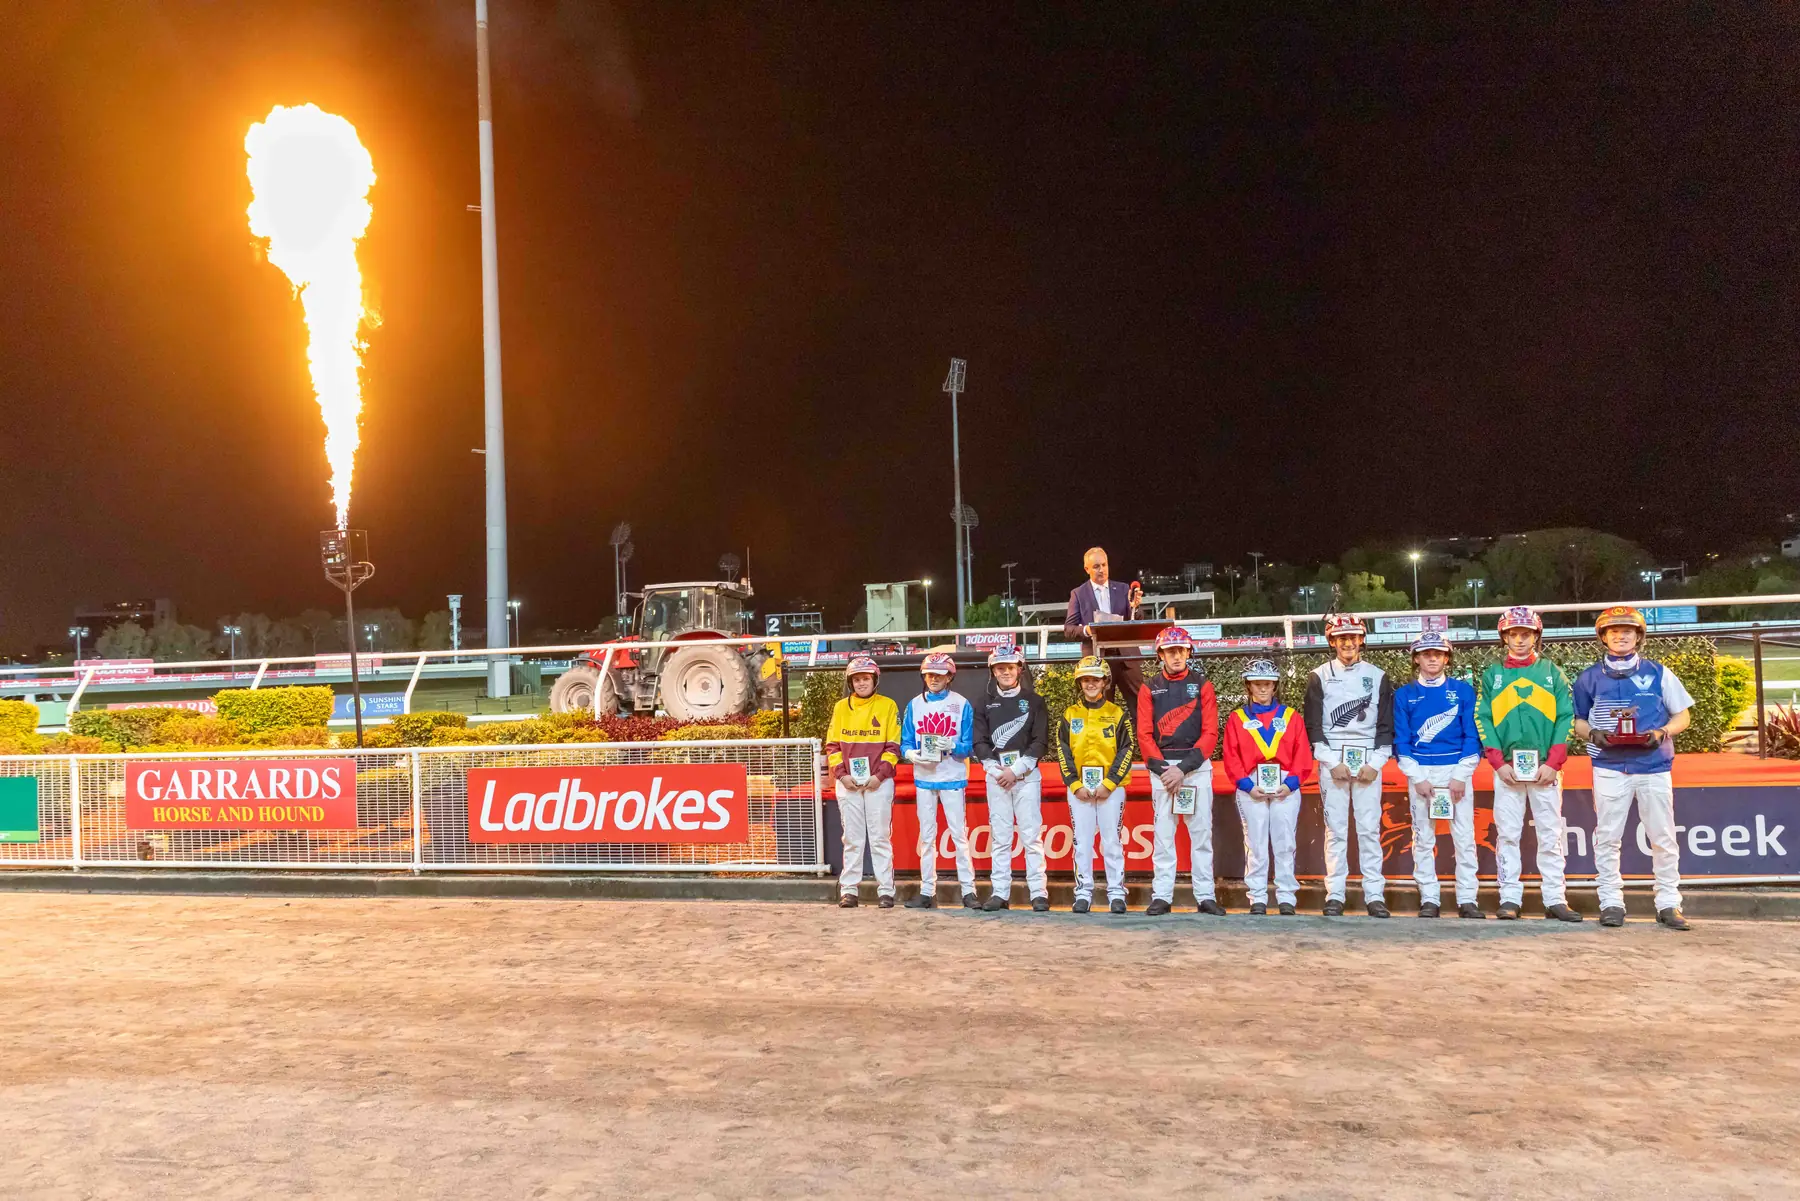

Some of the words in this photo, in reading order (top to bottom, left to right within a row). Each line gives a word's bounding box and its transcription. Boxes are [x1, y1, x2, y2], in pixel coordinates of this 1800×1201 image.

[768, 617, 780, 632] 2
[965, 633, 1013, 644] adbrokes
[136, 767, 342, 801] GARRARDS
[479, 776, 734, 832] Ladbrokes
[153, 806, 213, 823] HORSE
[217, 806, 254, 822] AND
[258, 805, 325, 822] HOUND
